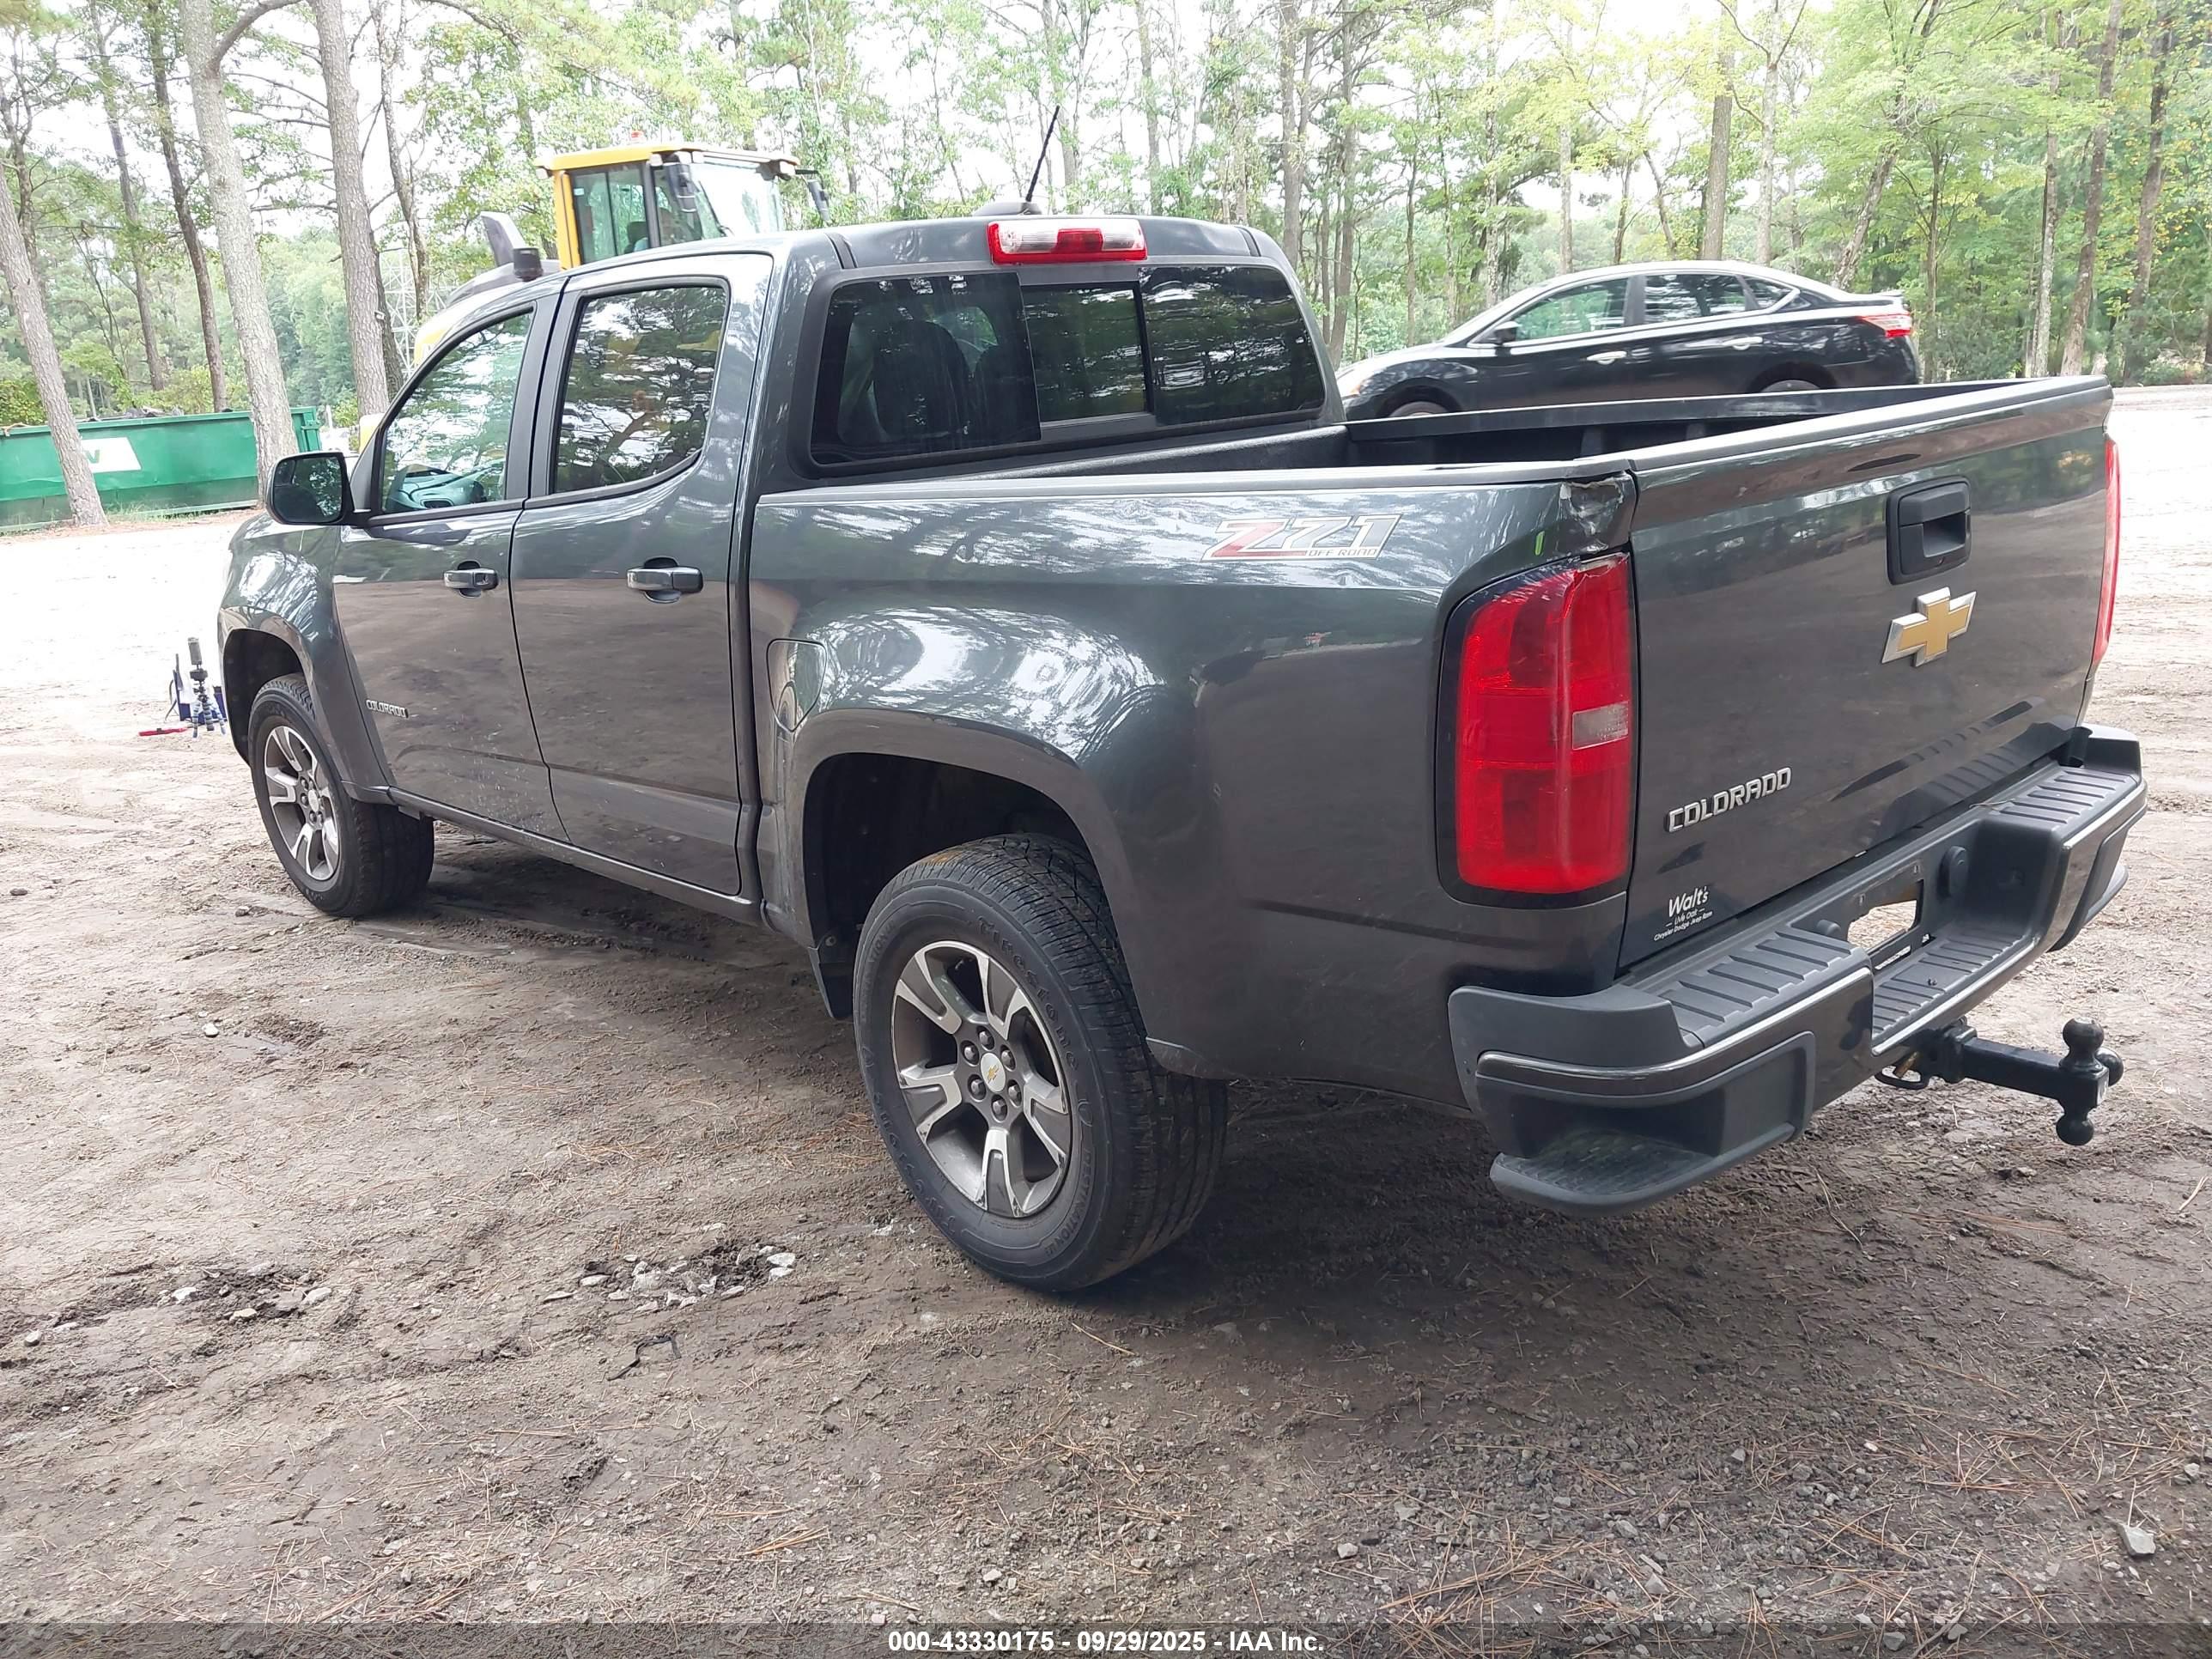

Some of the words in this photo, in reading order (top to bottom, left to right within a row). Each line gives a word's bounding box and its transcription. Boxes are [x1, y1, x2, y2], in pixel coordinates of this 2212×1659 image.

[1200, 514, 1403, 562] Z71
[1308, 549, 1334, 557] OFF
[1338, 548, 1377, 556] ROAD
[366, 699, 407, 719] COLORADO
[1667, 766, 1792, 833] COLORADO
[1668, 885, 1709, 918] Walt's
